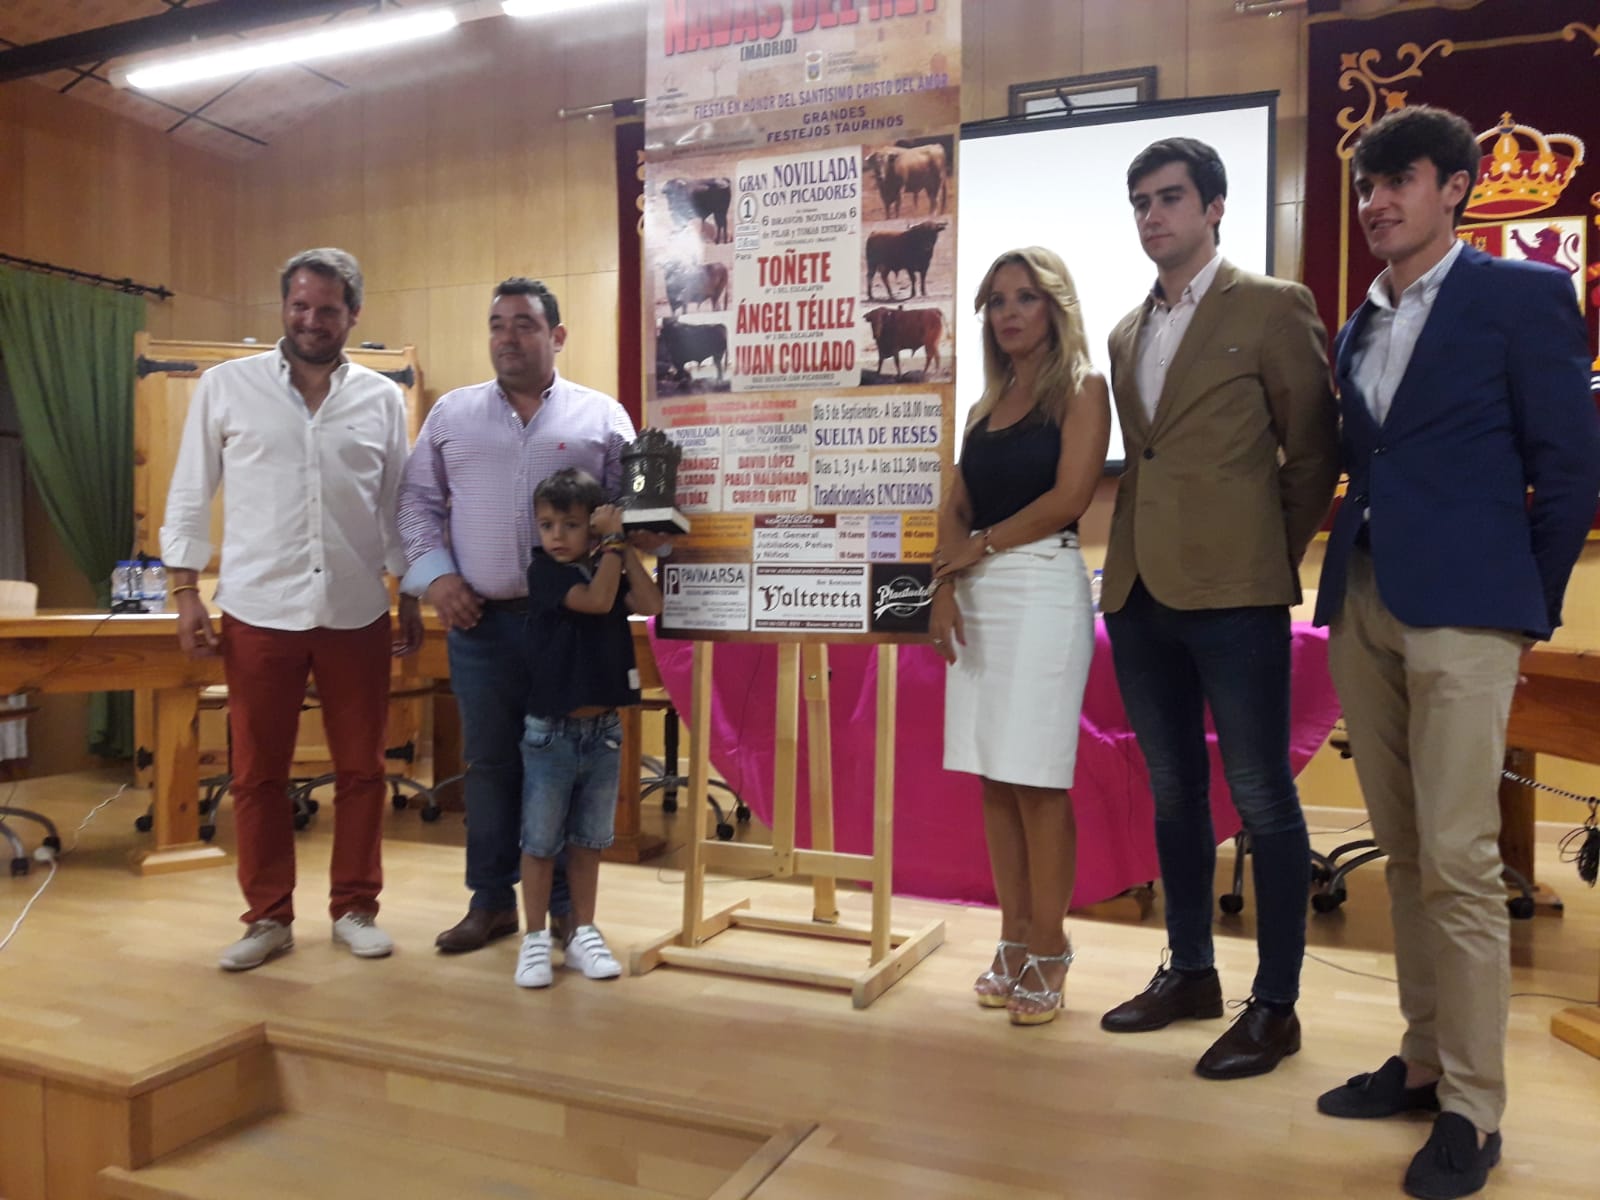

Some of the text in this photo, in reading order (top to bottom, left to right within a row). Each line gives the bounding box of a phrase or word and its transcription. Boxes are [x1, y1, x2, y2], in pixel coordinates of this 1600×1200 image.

[694, 102, 726, 119] FIESTA
[727, 99, 741, 116] EN
[778, 92, 797, 108] DEL
[856, 80, 893, 99] CRISTO
[896, 77, 916, 93] DEL
[918, 73, 949, 90] AMOR
[803, 106, 866, 125] GRANDES
[767, 114, 904, 142] FESTEJOS TAURINOS
[739, 156, 858, 193] GRAN NOVILLADA
[762, 183, 857, 207] CON PICADORES
[743, 200, 752, 219] 1
[762, 215, 769, 227] 6
[849, 207, 857, 218] 6
[757, 249, 831, 287] TOÑETE
[736, 293, 856, 334] ÁNGEL TÉLLEZ
[734, 339, 855, 376] JUAN COLLADO
[814, 425, 938, 446] SUELTA DE RESES
[738, 452, 795, 470] DAVID LÓPEZ
[724, 472, 752, 486] PABLO
[732, 489, 797, 503] CURRO ORTIZ
[814, 482, 933, 506] Tradicionales ENCIERROS
[758, 585, 862, 611] Voltereta
